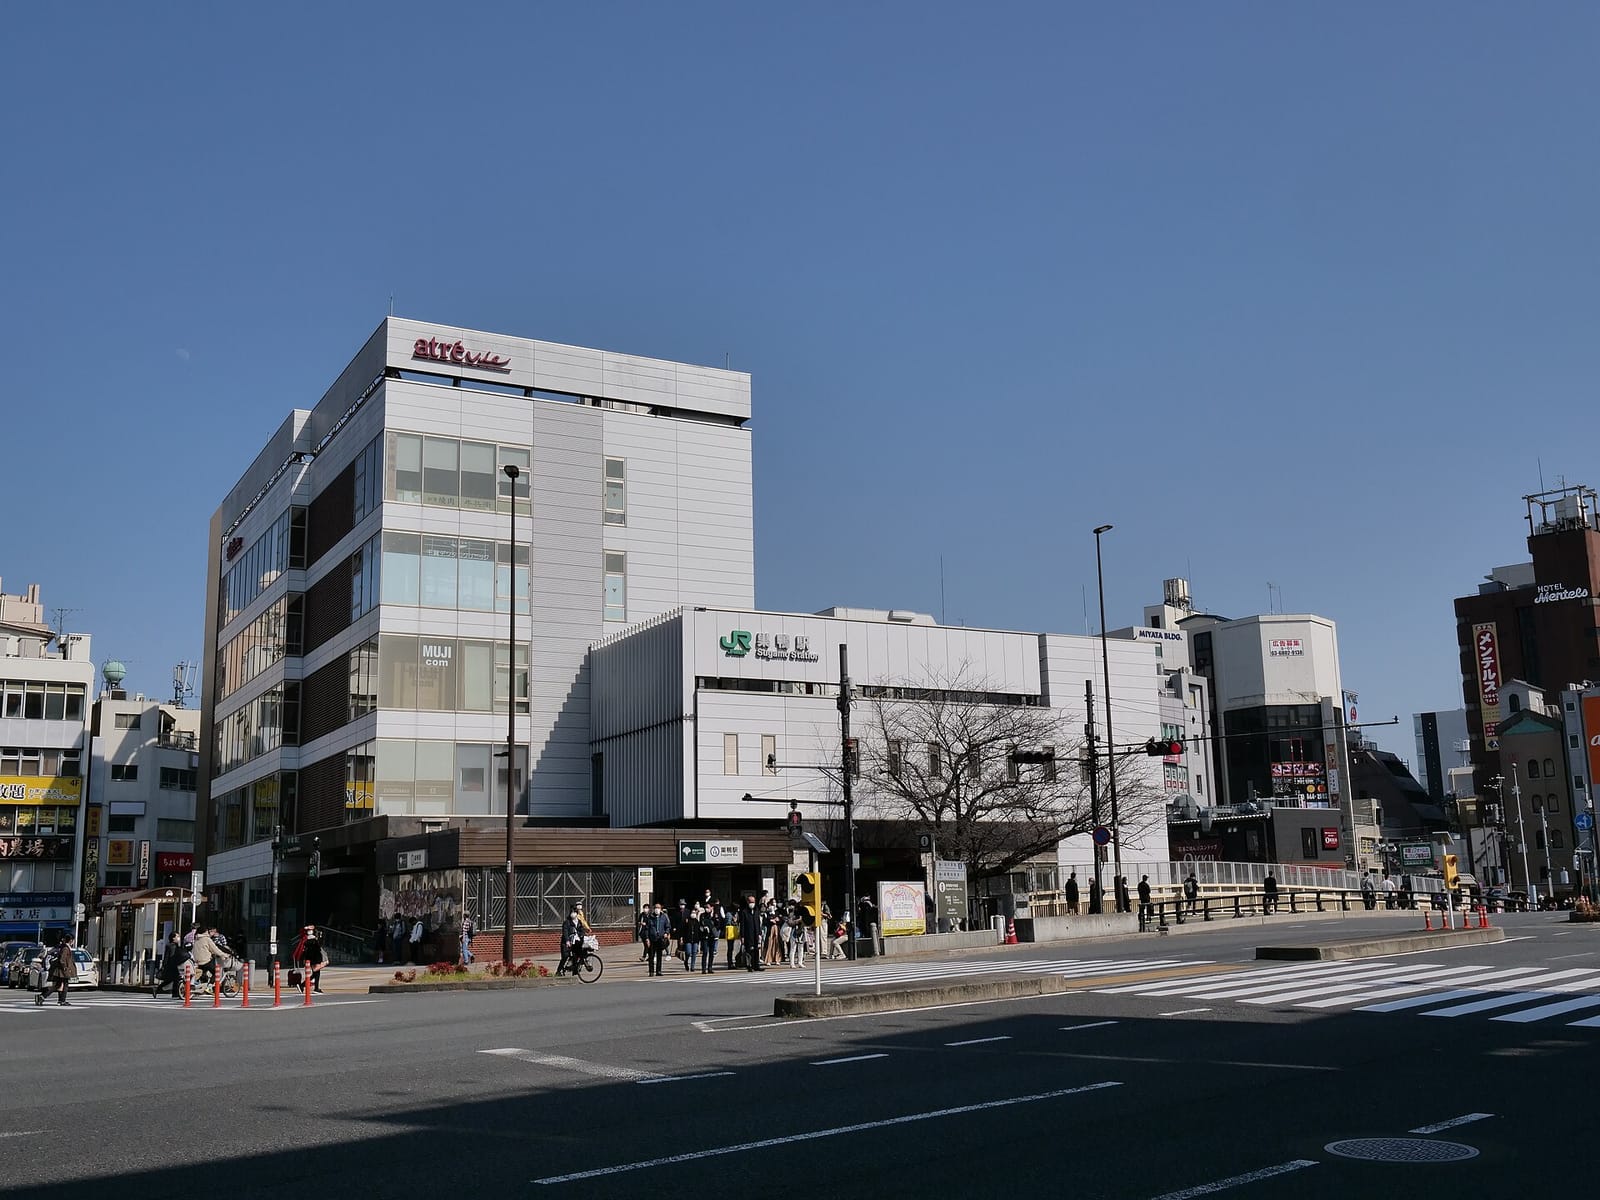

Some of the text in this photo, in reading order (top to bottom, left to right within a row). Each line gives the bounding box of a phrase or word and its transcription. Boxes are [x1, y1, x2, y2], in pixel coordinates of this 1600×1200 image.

[1537, 583, 1564, 593] HOTEL
[721, 630, 752, 651] JR
[1139, 630, 1183, 640] MIYATA BLDG.
[422, 644, 451, 658] MUJI
[757, 649, 789, 661] Sugamo
[425, 659, 449, 667] com
[1480, 632, 1497, 693] メンテルス
